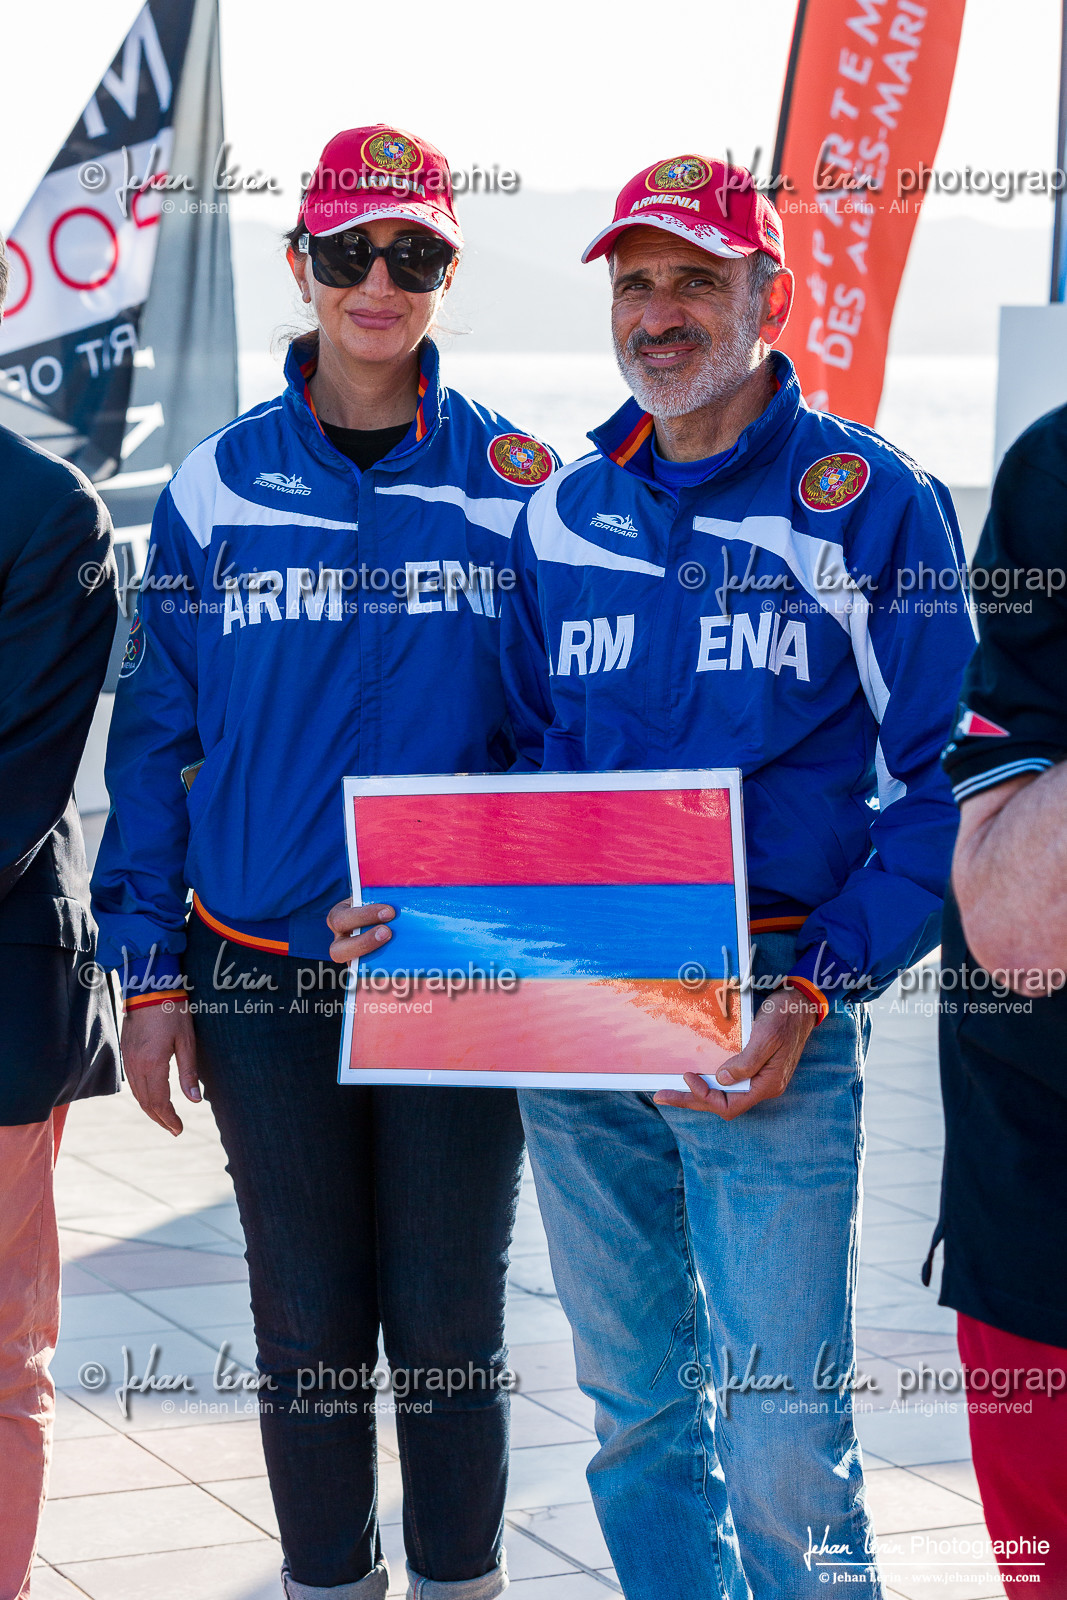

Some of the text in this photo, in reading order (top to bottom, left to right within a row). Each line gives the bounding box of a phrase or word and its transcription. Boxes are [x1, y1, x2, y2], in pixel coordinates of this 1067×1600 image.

[357, 176, 426, 198] ARMENIA
[630, 194, 700, 213] ARMENIA
[821, 283, 866, 370] DES
[253, 479, 312, 496] FORWARD
[590, 520, 638, 538] FORWARD
[222, 560, 502, 636] ARM ENI
[548, 611, 810, 682] RM ENIA
